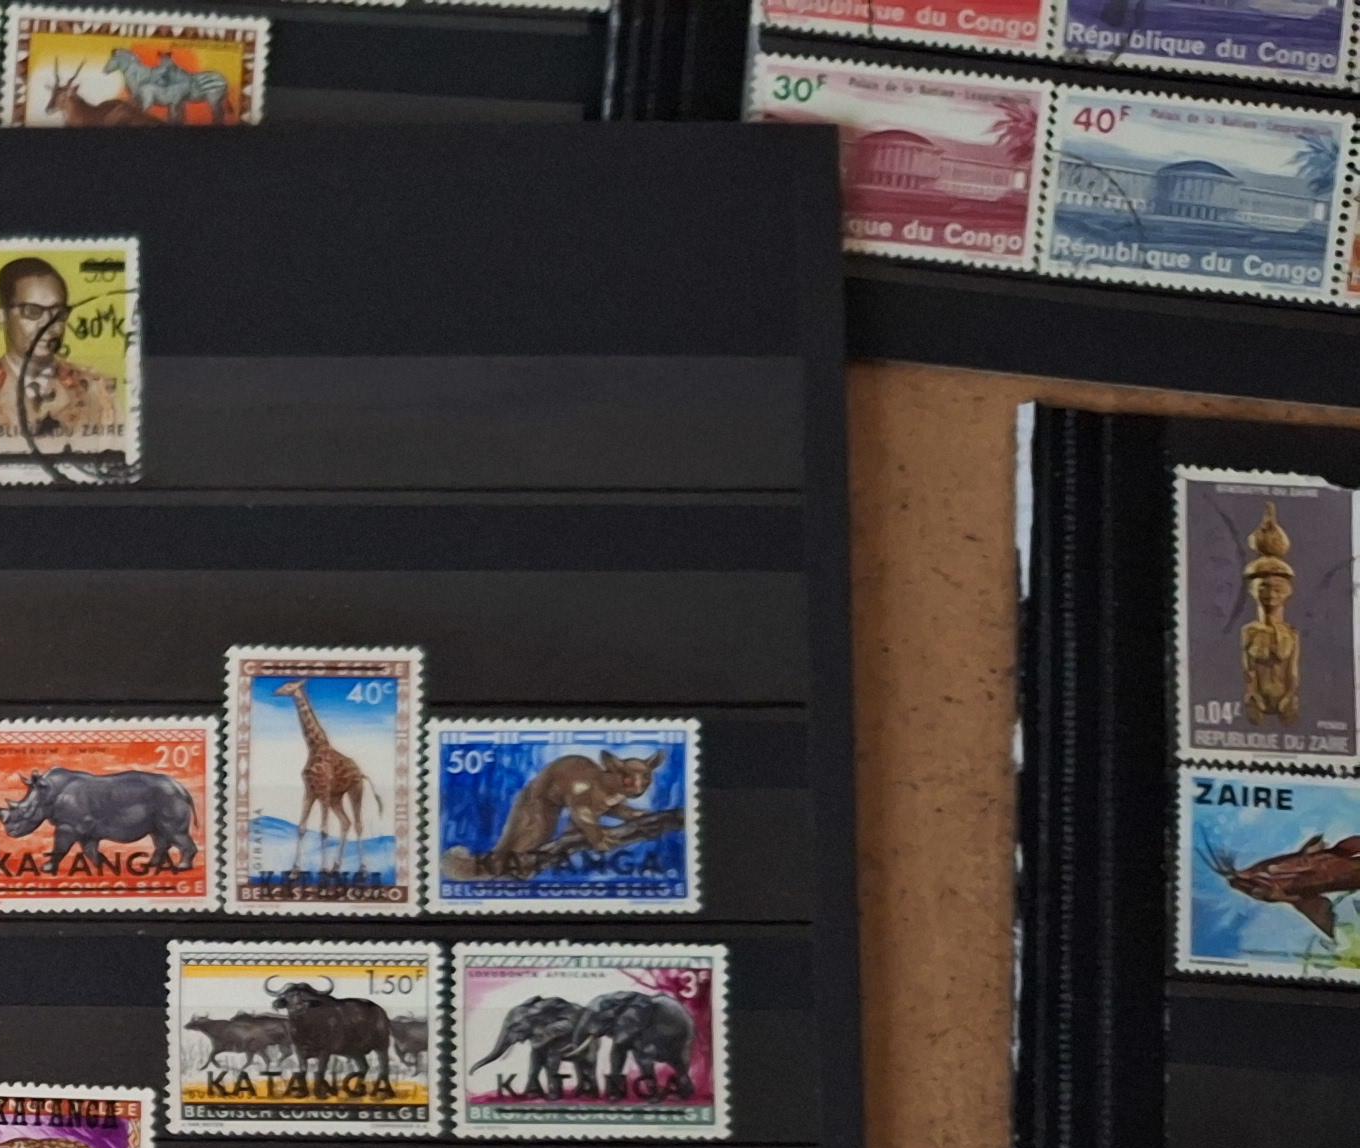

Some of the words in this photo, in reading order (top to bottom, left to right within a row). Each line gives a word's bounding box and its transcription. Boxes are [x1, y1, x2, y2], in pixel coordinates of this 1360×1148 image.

[917, 8, 947, 26] du
[959, 10, 1036, 37] Congo
[1216, 39, 1247, 60] du
[1258, 42, 1336, 70] Congo
[904, 221, 933, 241] du
[946, 223, 1023, 251] Congo
[1200, 252, 1232, 274] du
[1243, 255, 1321, 282] Congo
[1194, 783, 1294, 811] ZAIRE
[481, 851, 663, 878] KATANGA
[206, 1070, 396, 1099] KATANGA
[496, 1072, 693, 1100] KATANGA
